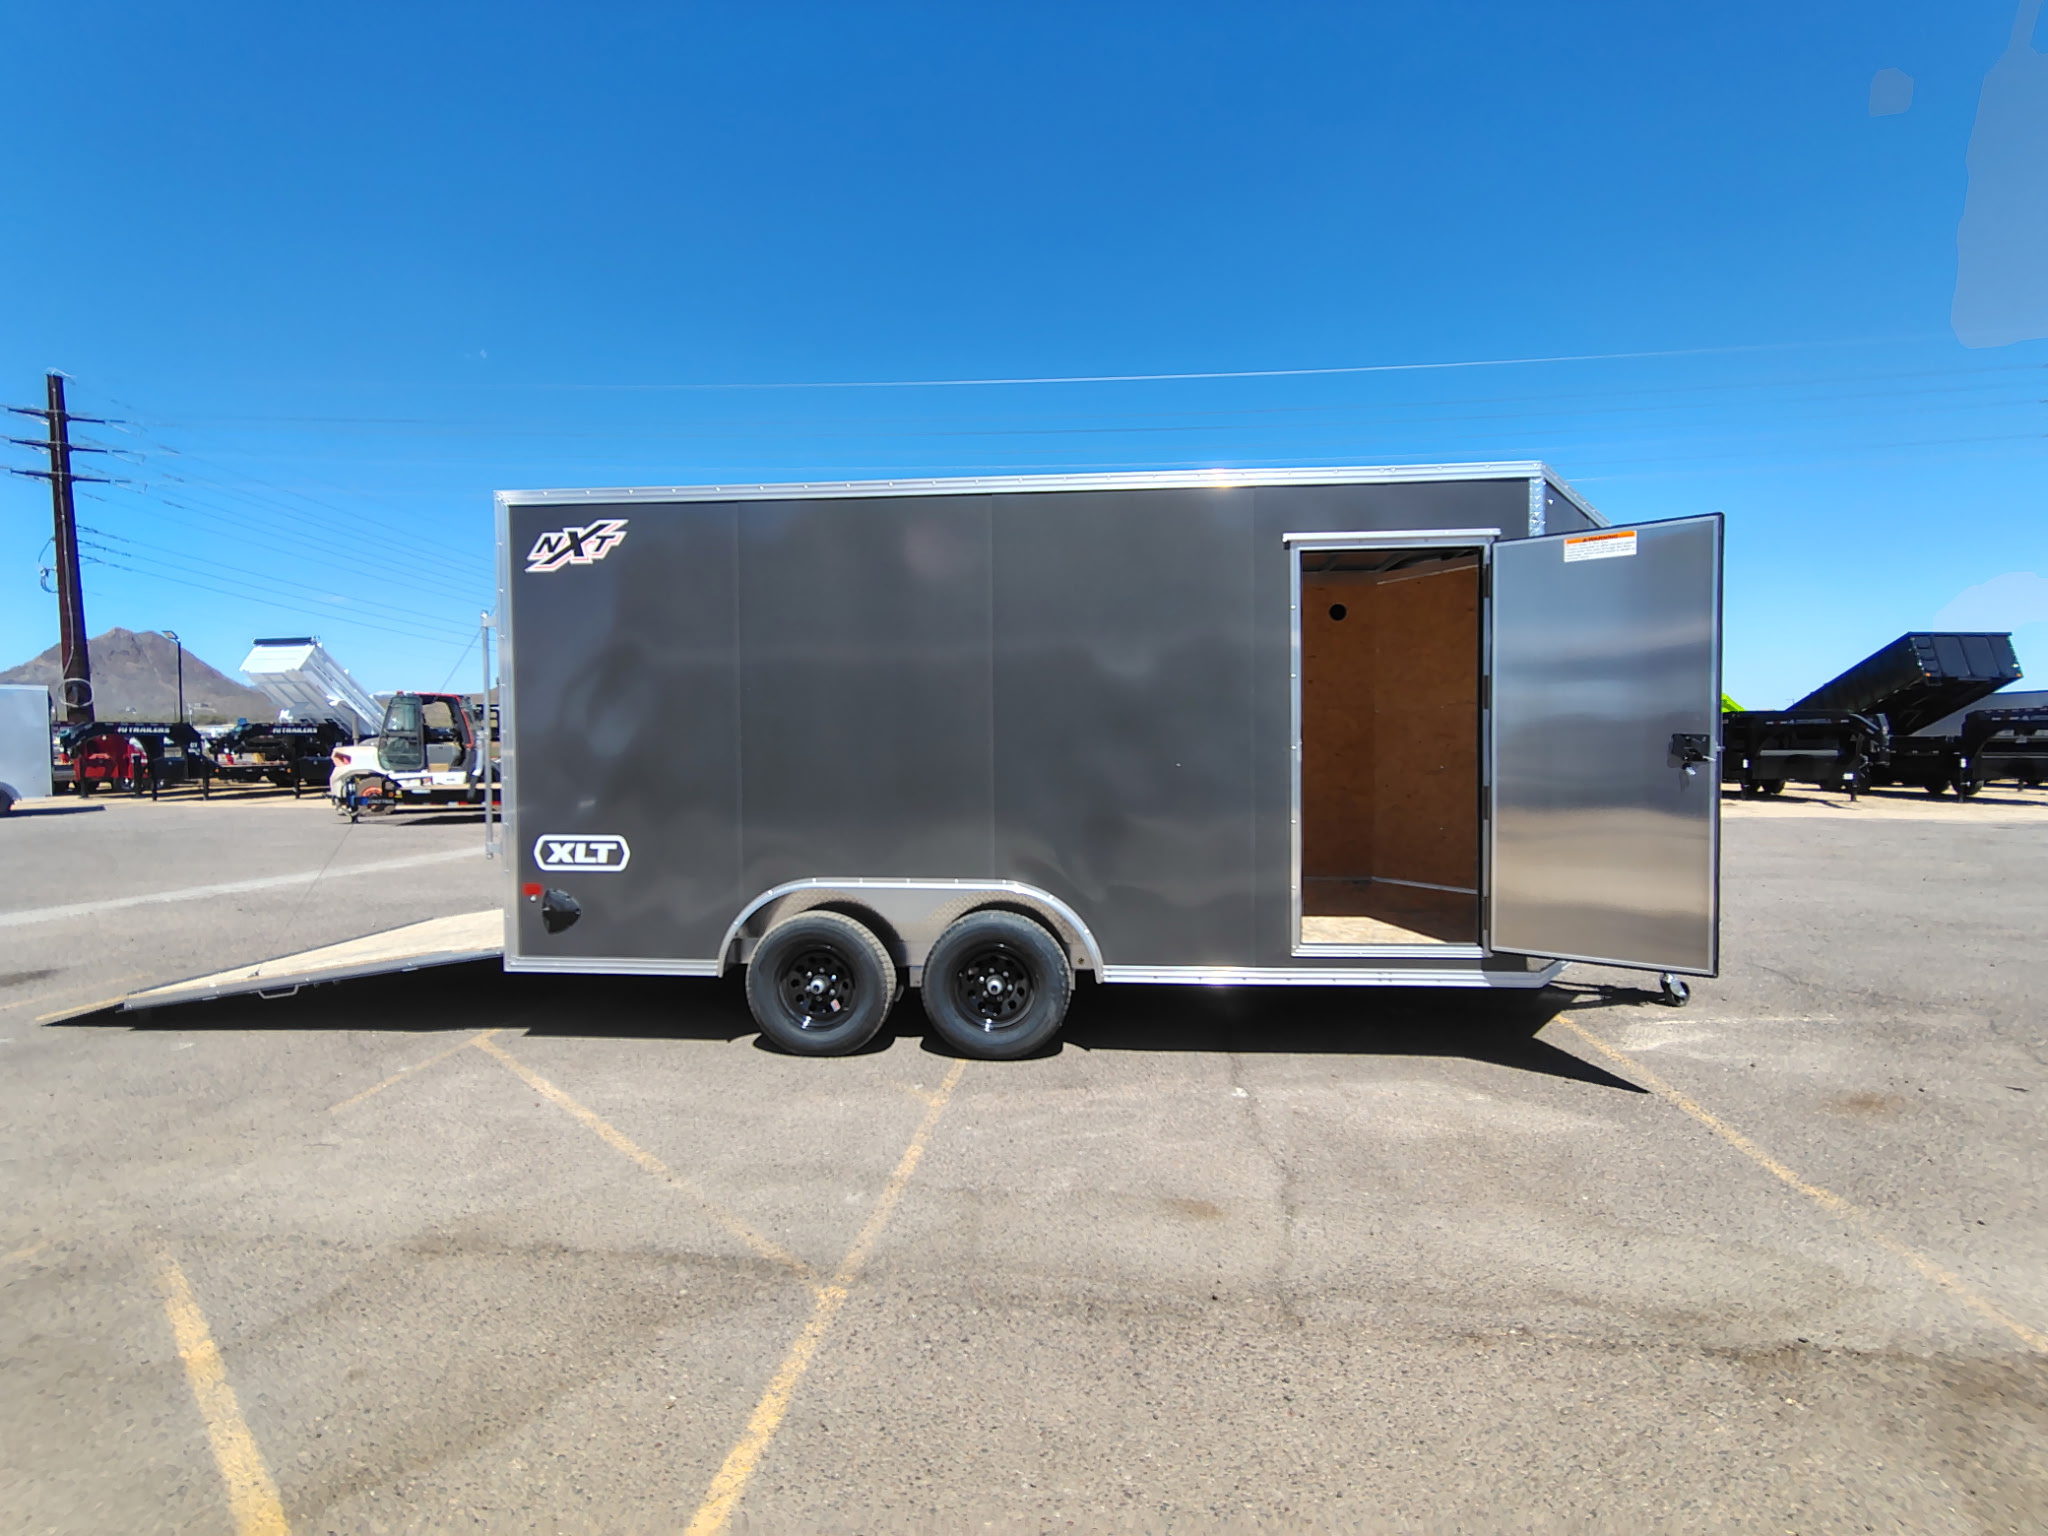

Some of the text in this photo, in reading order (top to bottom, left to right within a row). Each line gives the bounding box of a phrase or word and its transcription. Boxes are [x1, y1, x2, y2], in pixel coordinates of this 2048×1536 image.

[527, 520, 626, 571] NXT
[128, 726, 171, 734] TRAILERS
[546, 842, 618, 864] XLT
